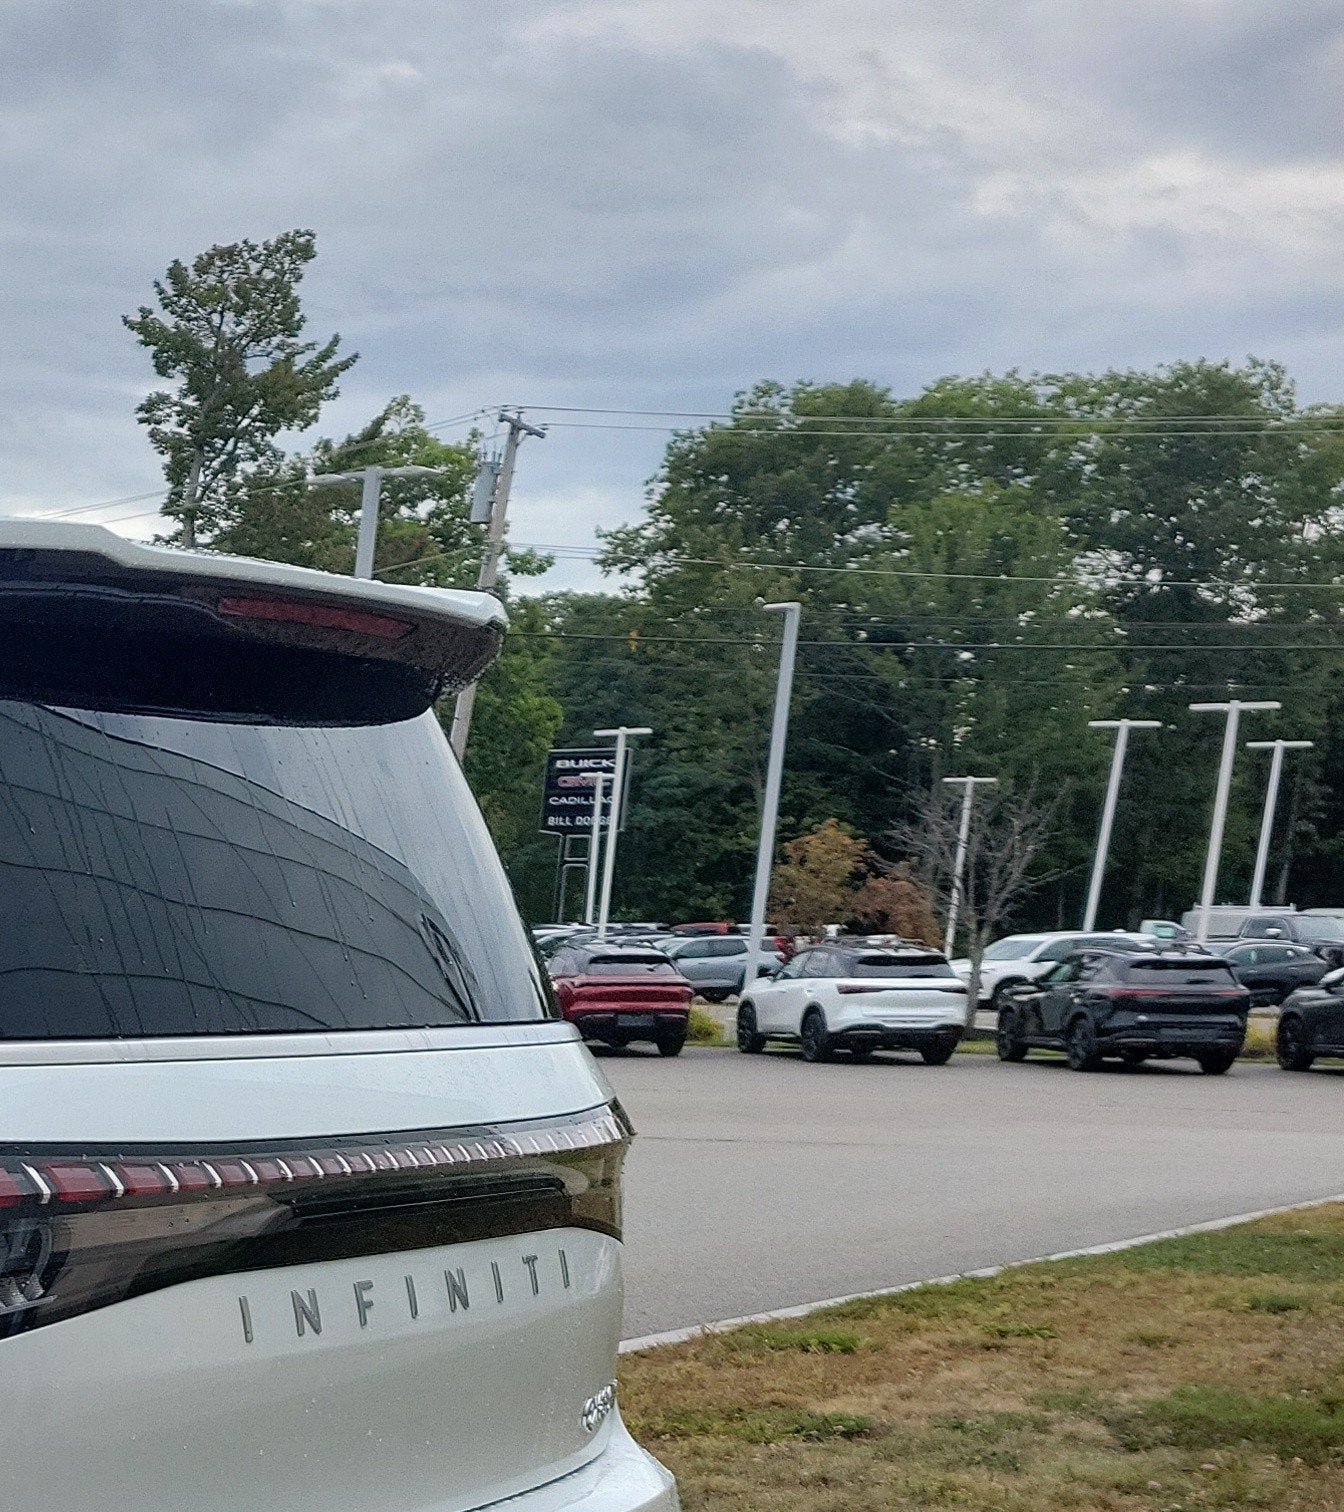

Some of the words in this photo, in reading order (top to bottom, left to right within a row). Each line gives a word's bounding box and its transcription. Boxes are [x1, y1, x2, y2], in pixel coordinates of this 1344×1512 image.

[556, 759, 616, 769] BUICK
[548, 816, 573, 826] BILL
[575, 816, 613, 826] DOGE
[238, 1249, 571, 1344] INFINITI
